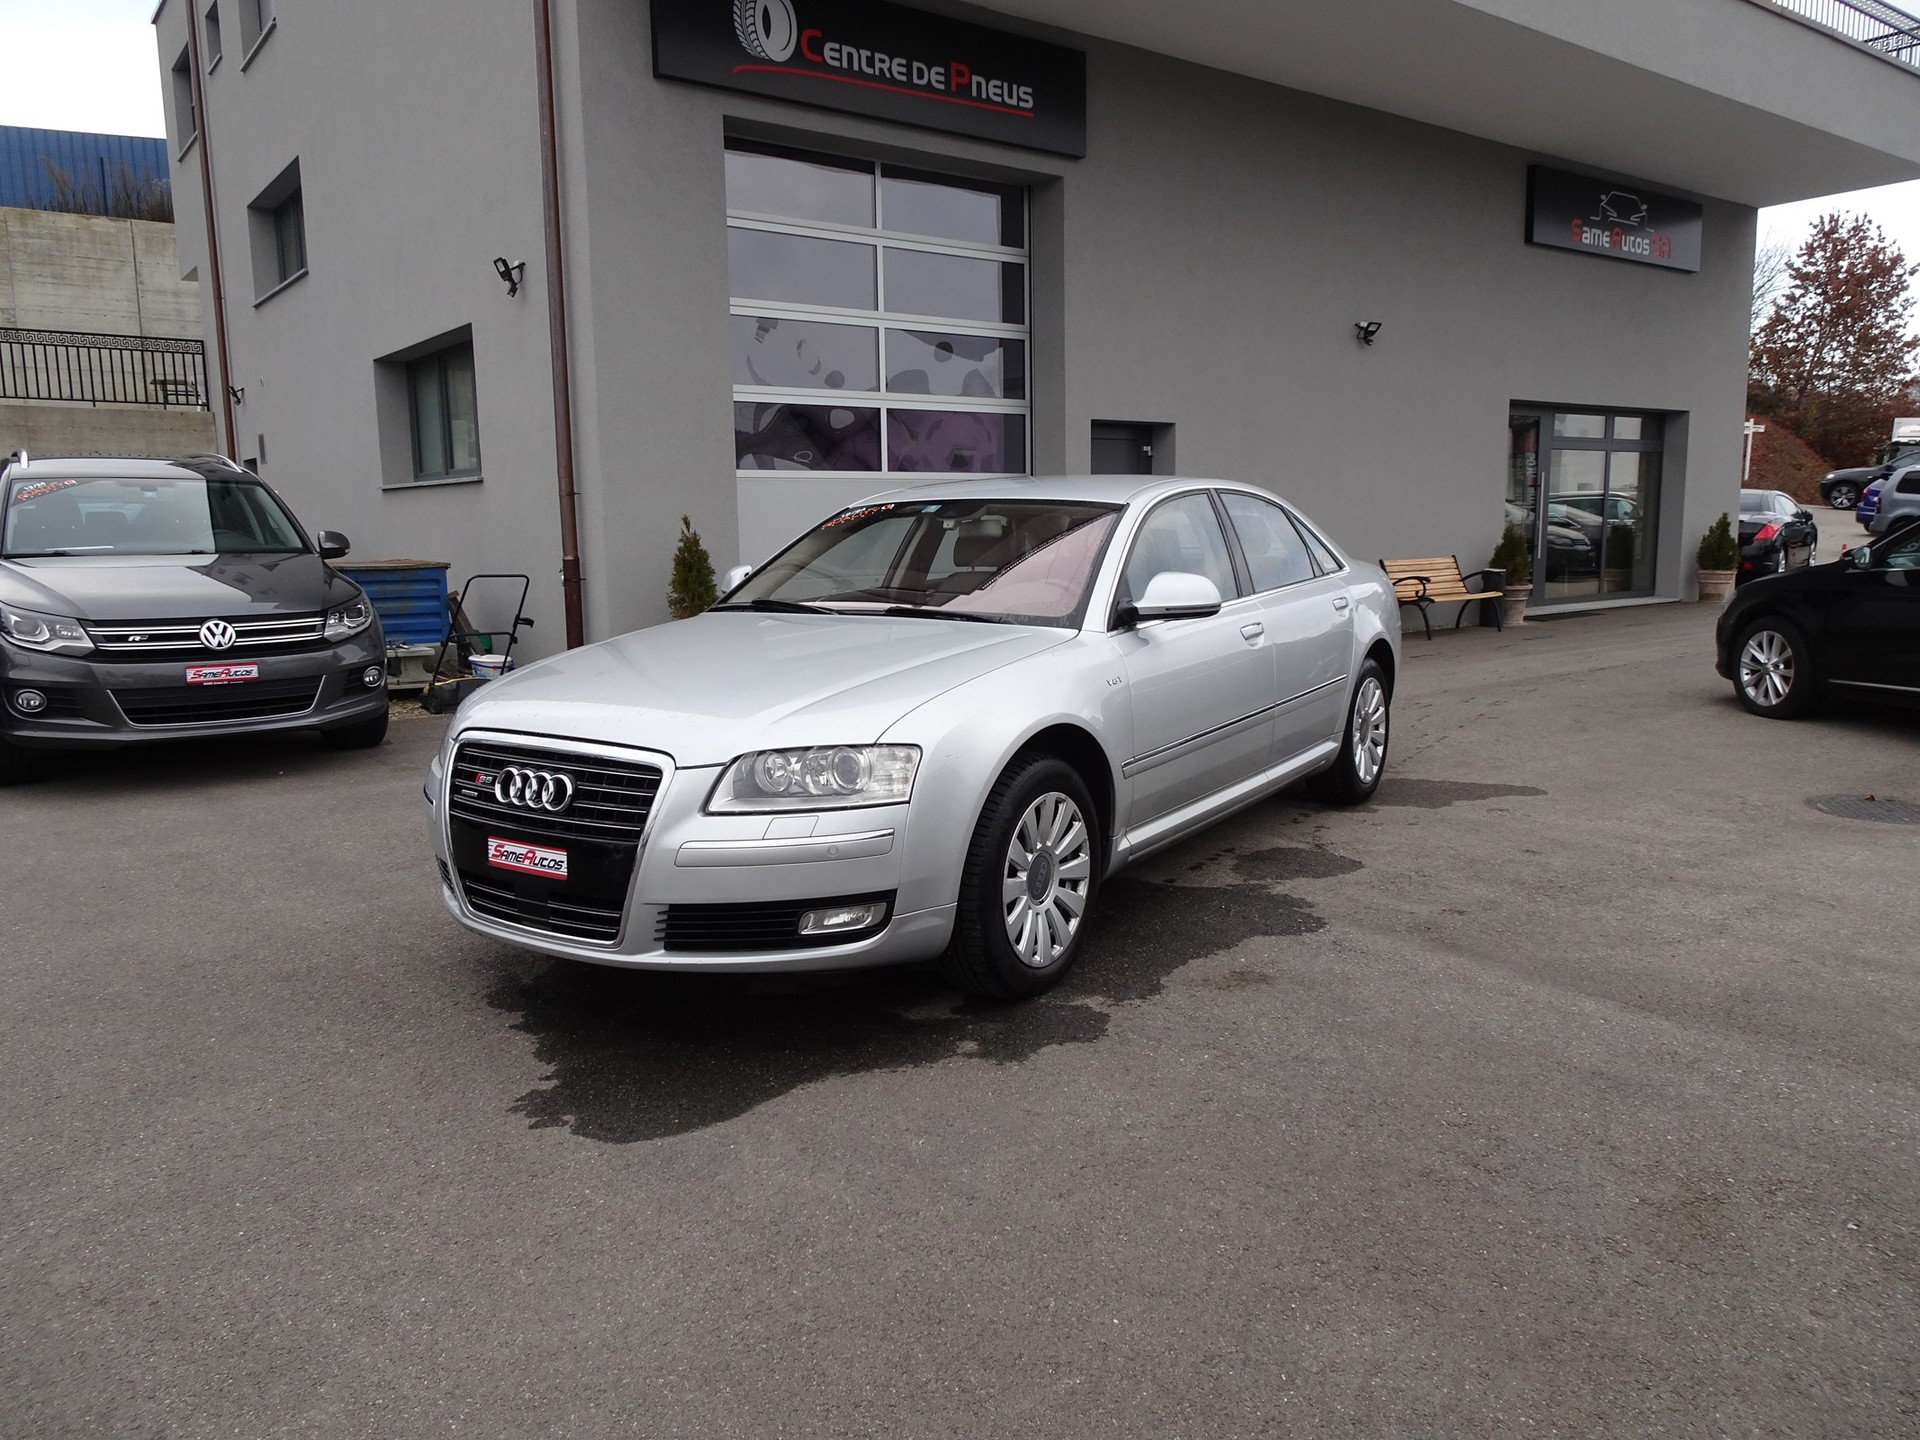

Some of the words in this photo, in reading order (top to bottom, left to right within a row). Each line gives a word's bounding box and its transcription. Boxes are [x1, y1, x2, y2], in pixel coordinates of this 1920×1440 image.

[800, 29, 907, 82] CENTRE
[912, 61, 945, 90] DE
[950, 61, 1034, 109] PNEUS
